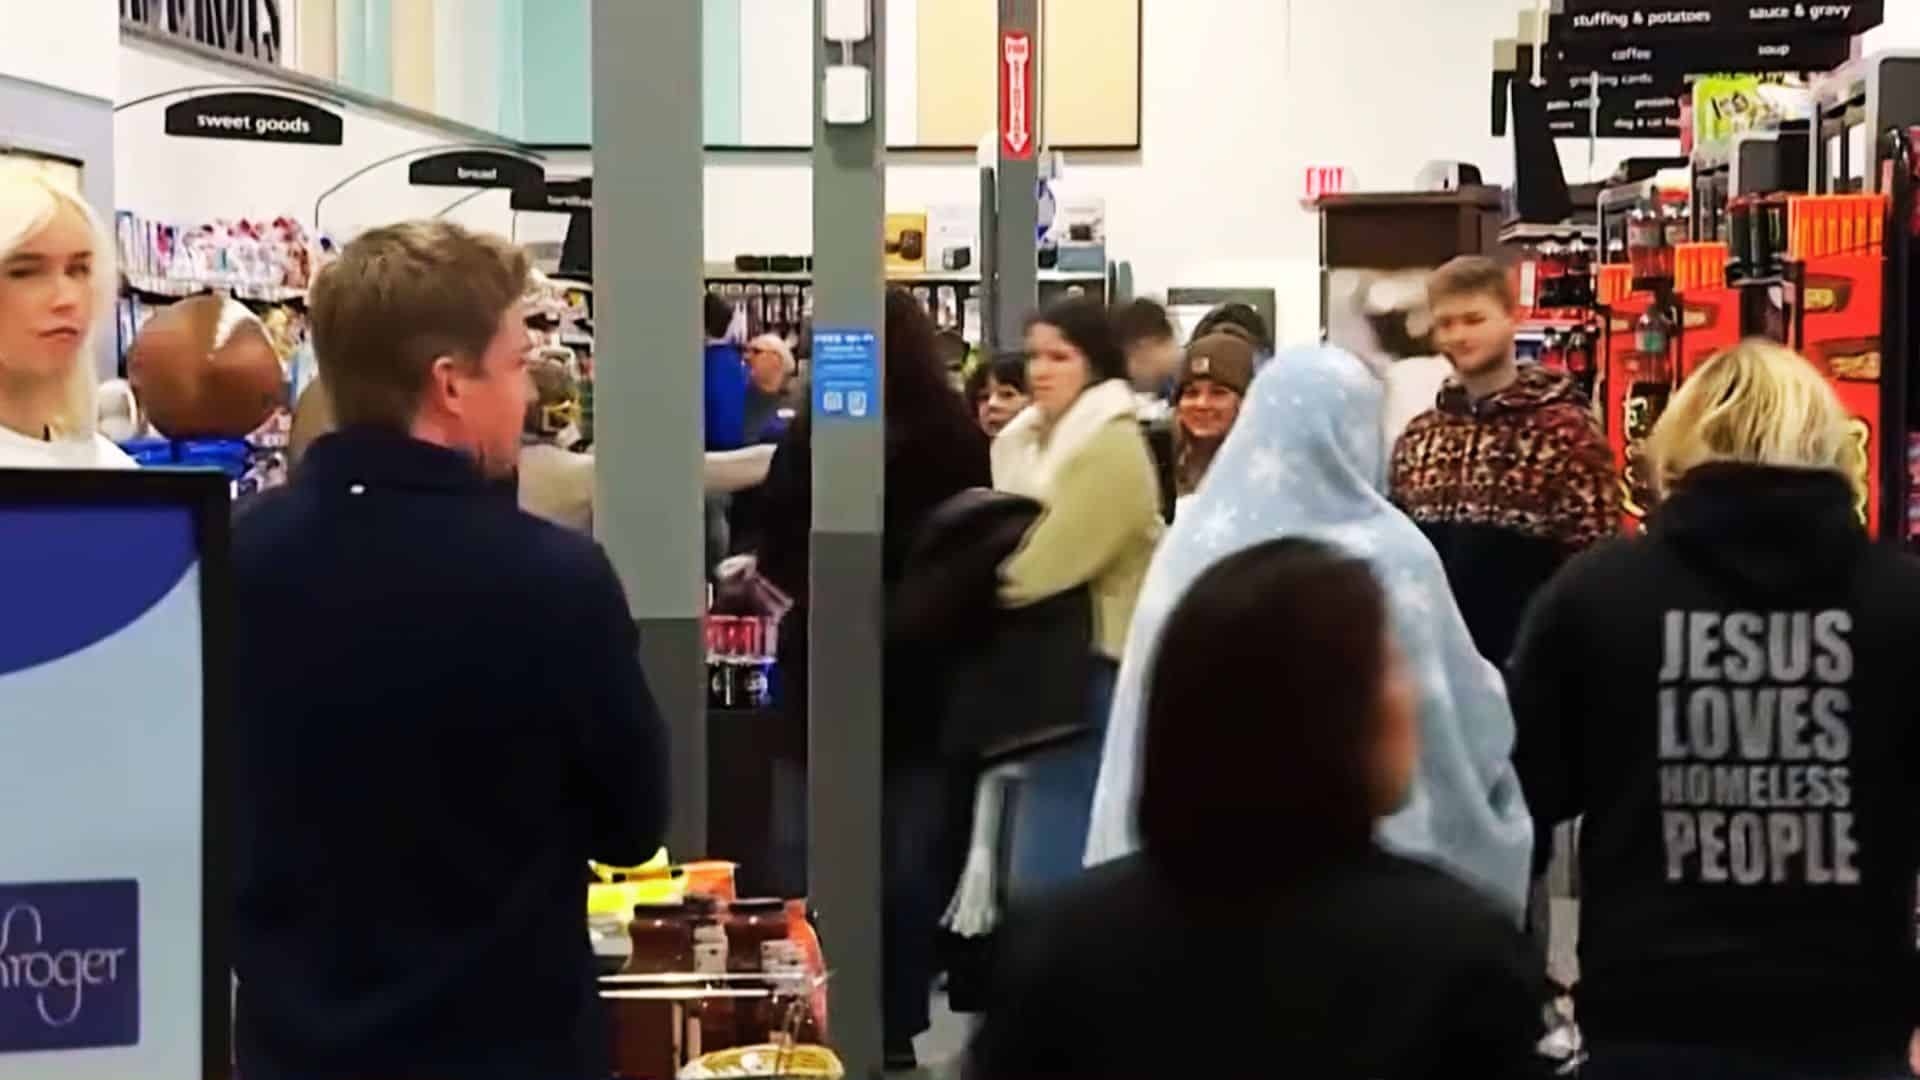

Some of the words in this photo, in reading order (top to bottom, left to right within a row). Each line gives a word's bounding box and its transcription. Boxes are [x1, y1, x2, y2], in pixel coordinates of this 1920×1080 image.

[1573, 11, 1628, 28] stuffing
[1632, 11, 1643, 25] &
[1648, 10, 1711, 26] potatoes
[1749, 8, 1789, 19] sauce
[1794, 4, 1805, 18] &
[1809, 4, 1851, 20] gravy
[1612, 47, 1651, 60] coffee
[1758, 44, 1790, 56] soup
[197, 114, 250, 130] sweet
[255, 117, 310, 134] goods
[457, 167, 497, 179] bread
[1306, 166, 1344, 195] EXIT
[1658, 609, 1854, 684] JESUS
[1657, 686, 1851, 762] LOVES
[1659, 764, 1850, 808] HOMELESS
[1662, 810, 1861, 885] PEOPLE
